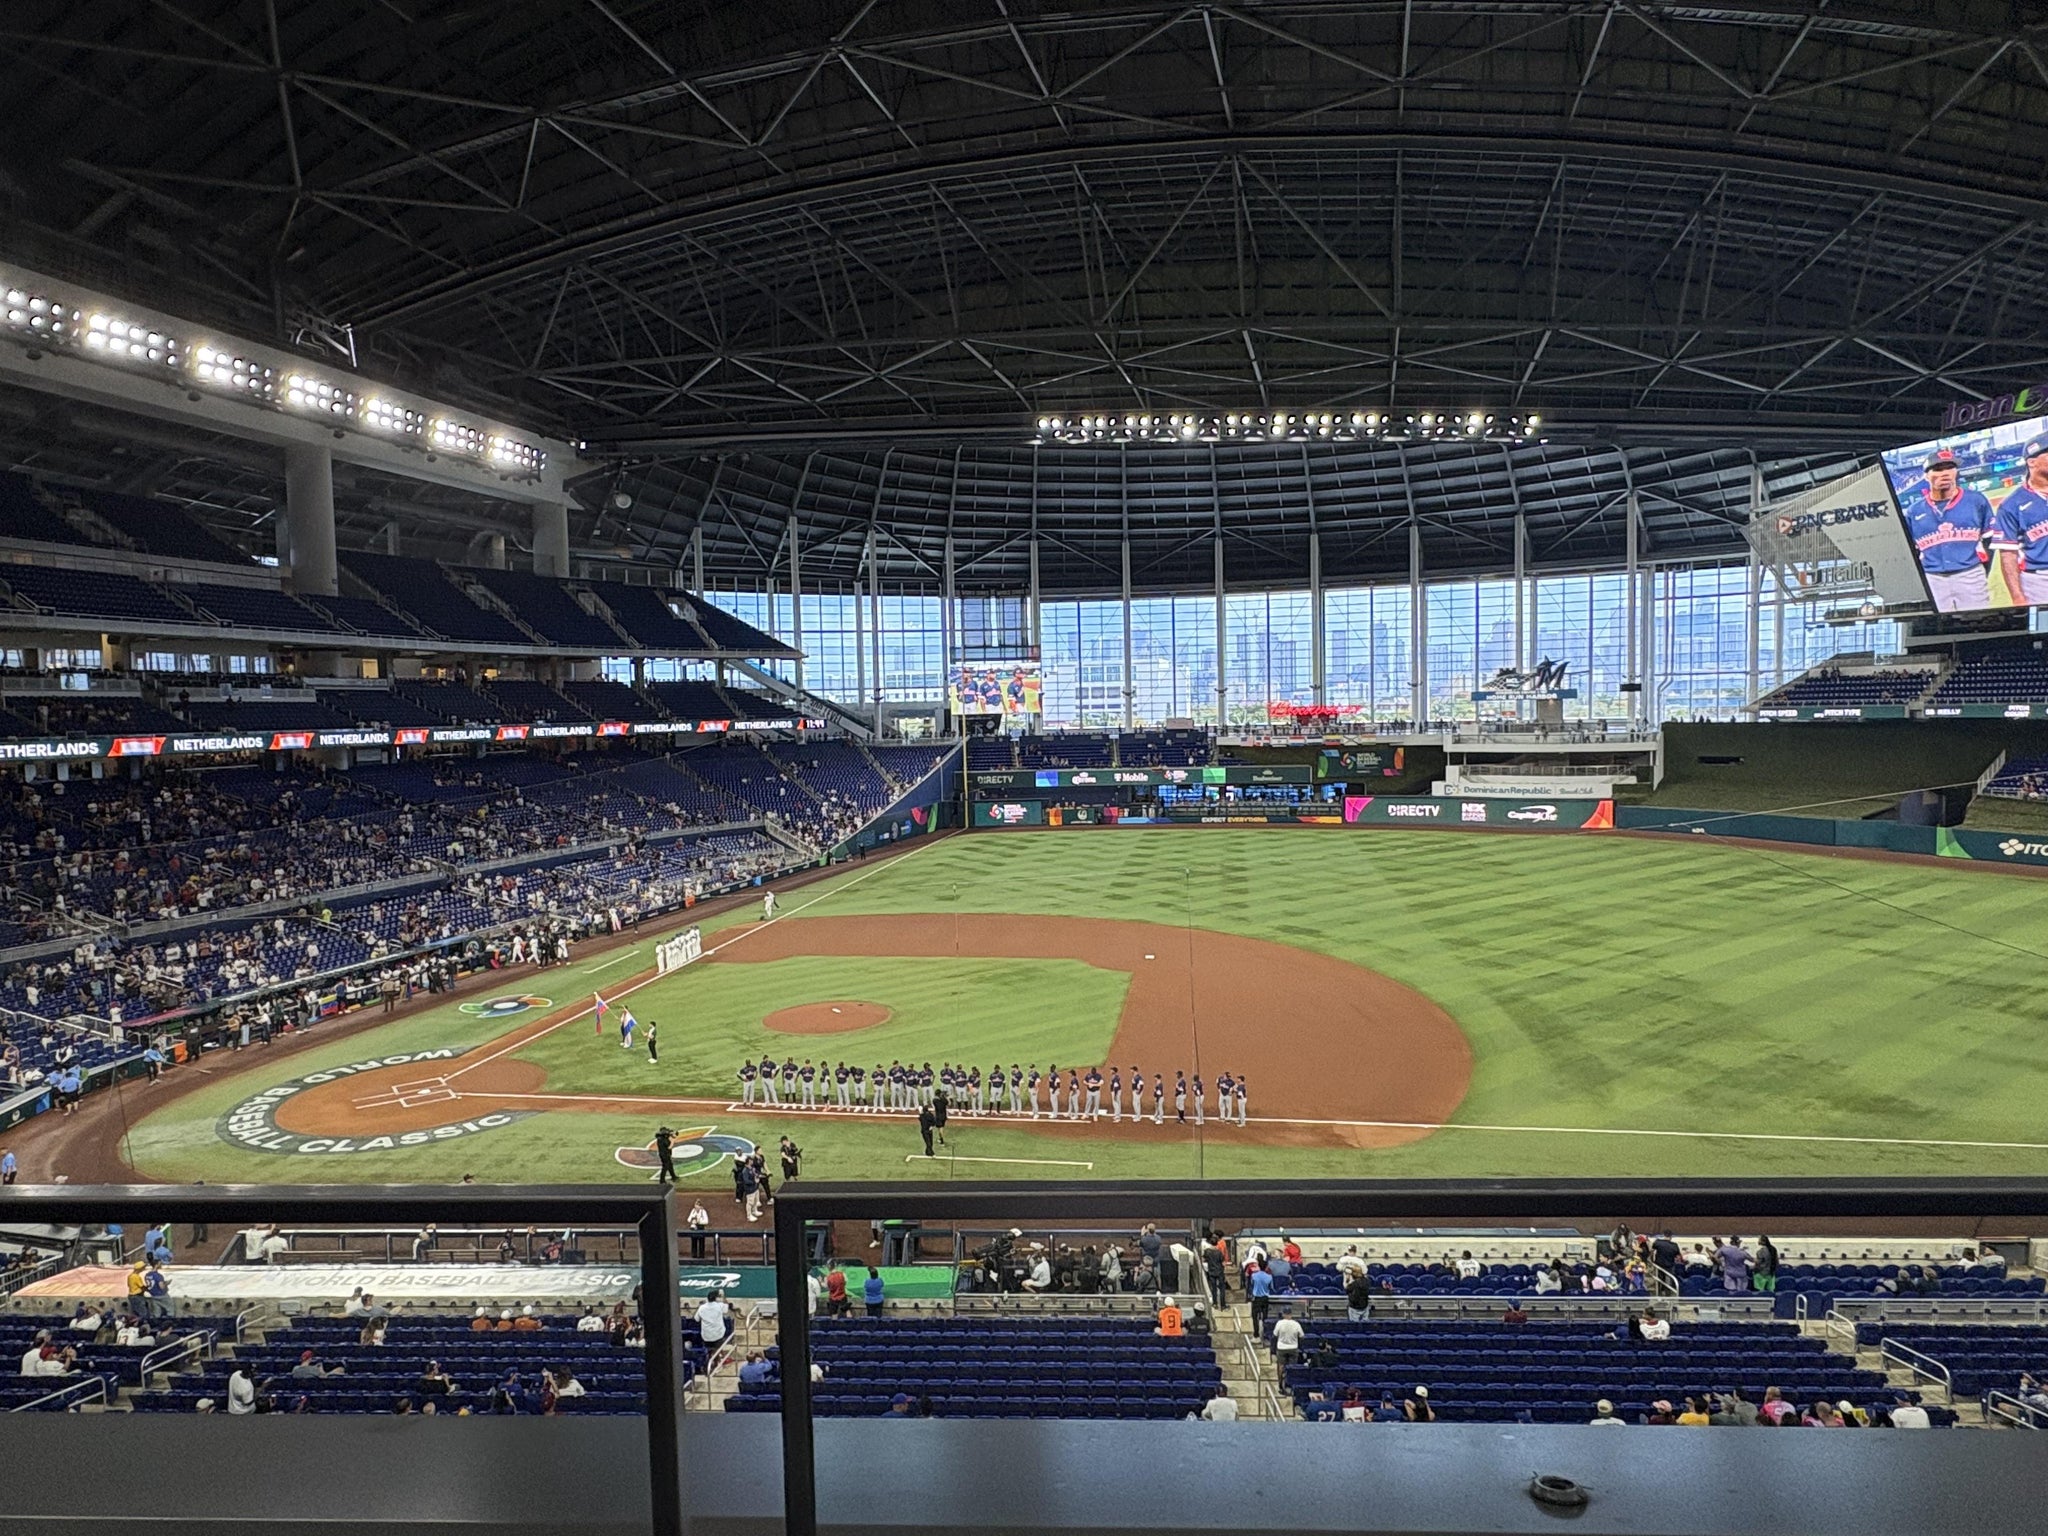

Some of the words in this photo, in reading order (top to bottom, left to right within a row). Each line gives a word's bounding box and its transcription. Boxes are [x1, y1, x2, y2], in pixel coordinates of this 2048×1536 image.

[633, 722, 693, 733] NETHERLANDS
[734, 718, 793, 730] NETHERLANDS
[433, 729, 492, 741] NETHERLANDS
[533, 726, 593, 737] NETHERLANDS
[173, 736, 264, 751] NETHERLANDS
[319, 732, 390, 746] NETHERLANDS
[977, 775, 1014, 785] DIRECTV
[1122, 773, 1149, 782] Mobile
[1387, 804, 1440, 817] DIRECTV
[303, 1049, 453, 1084] WORLD
[228, 1086, 300, 1150] BASEBALL
[298, 1114, 511, 1152] CLASSIC
[281, 1273, 374, 1287] WORLD
[379, 1274, 511, 1287] BASEBALL
[520, 1274, 632, 1287] CLASSIC
[1167, 1315, 1176, 1329] 9
[1317, 1410, 1336, 1423] 27
